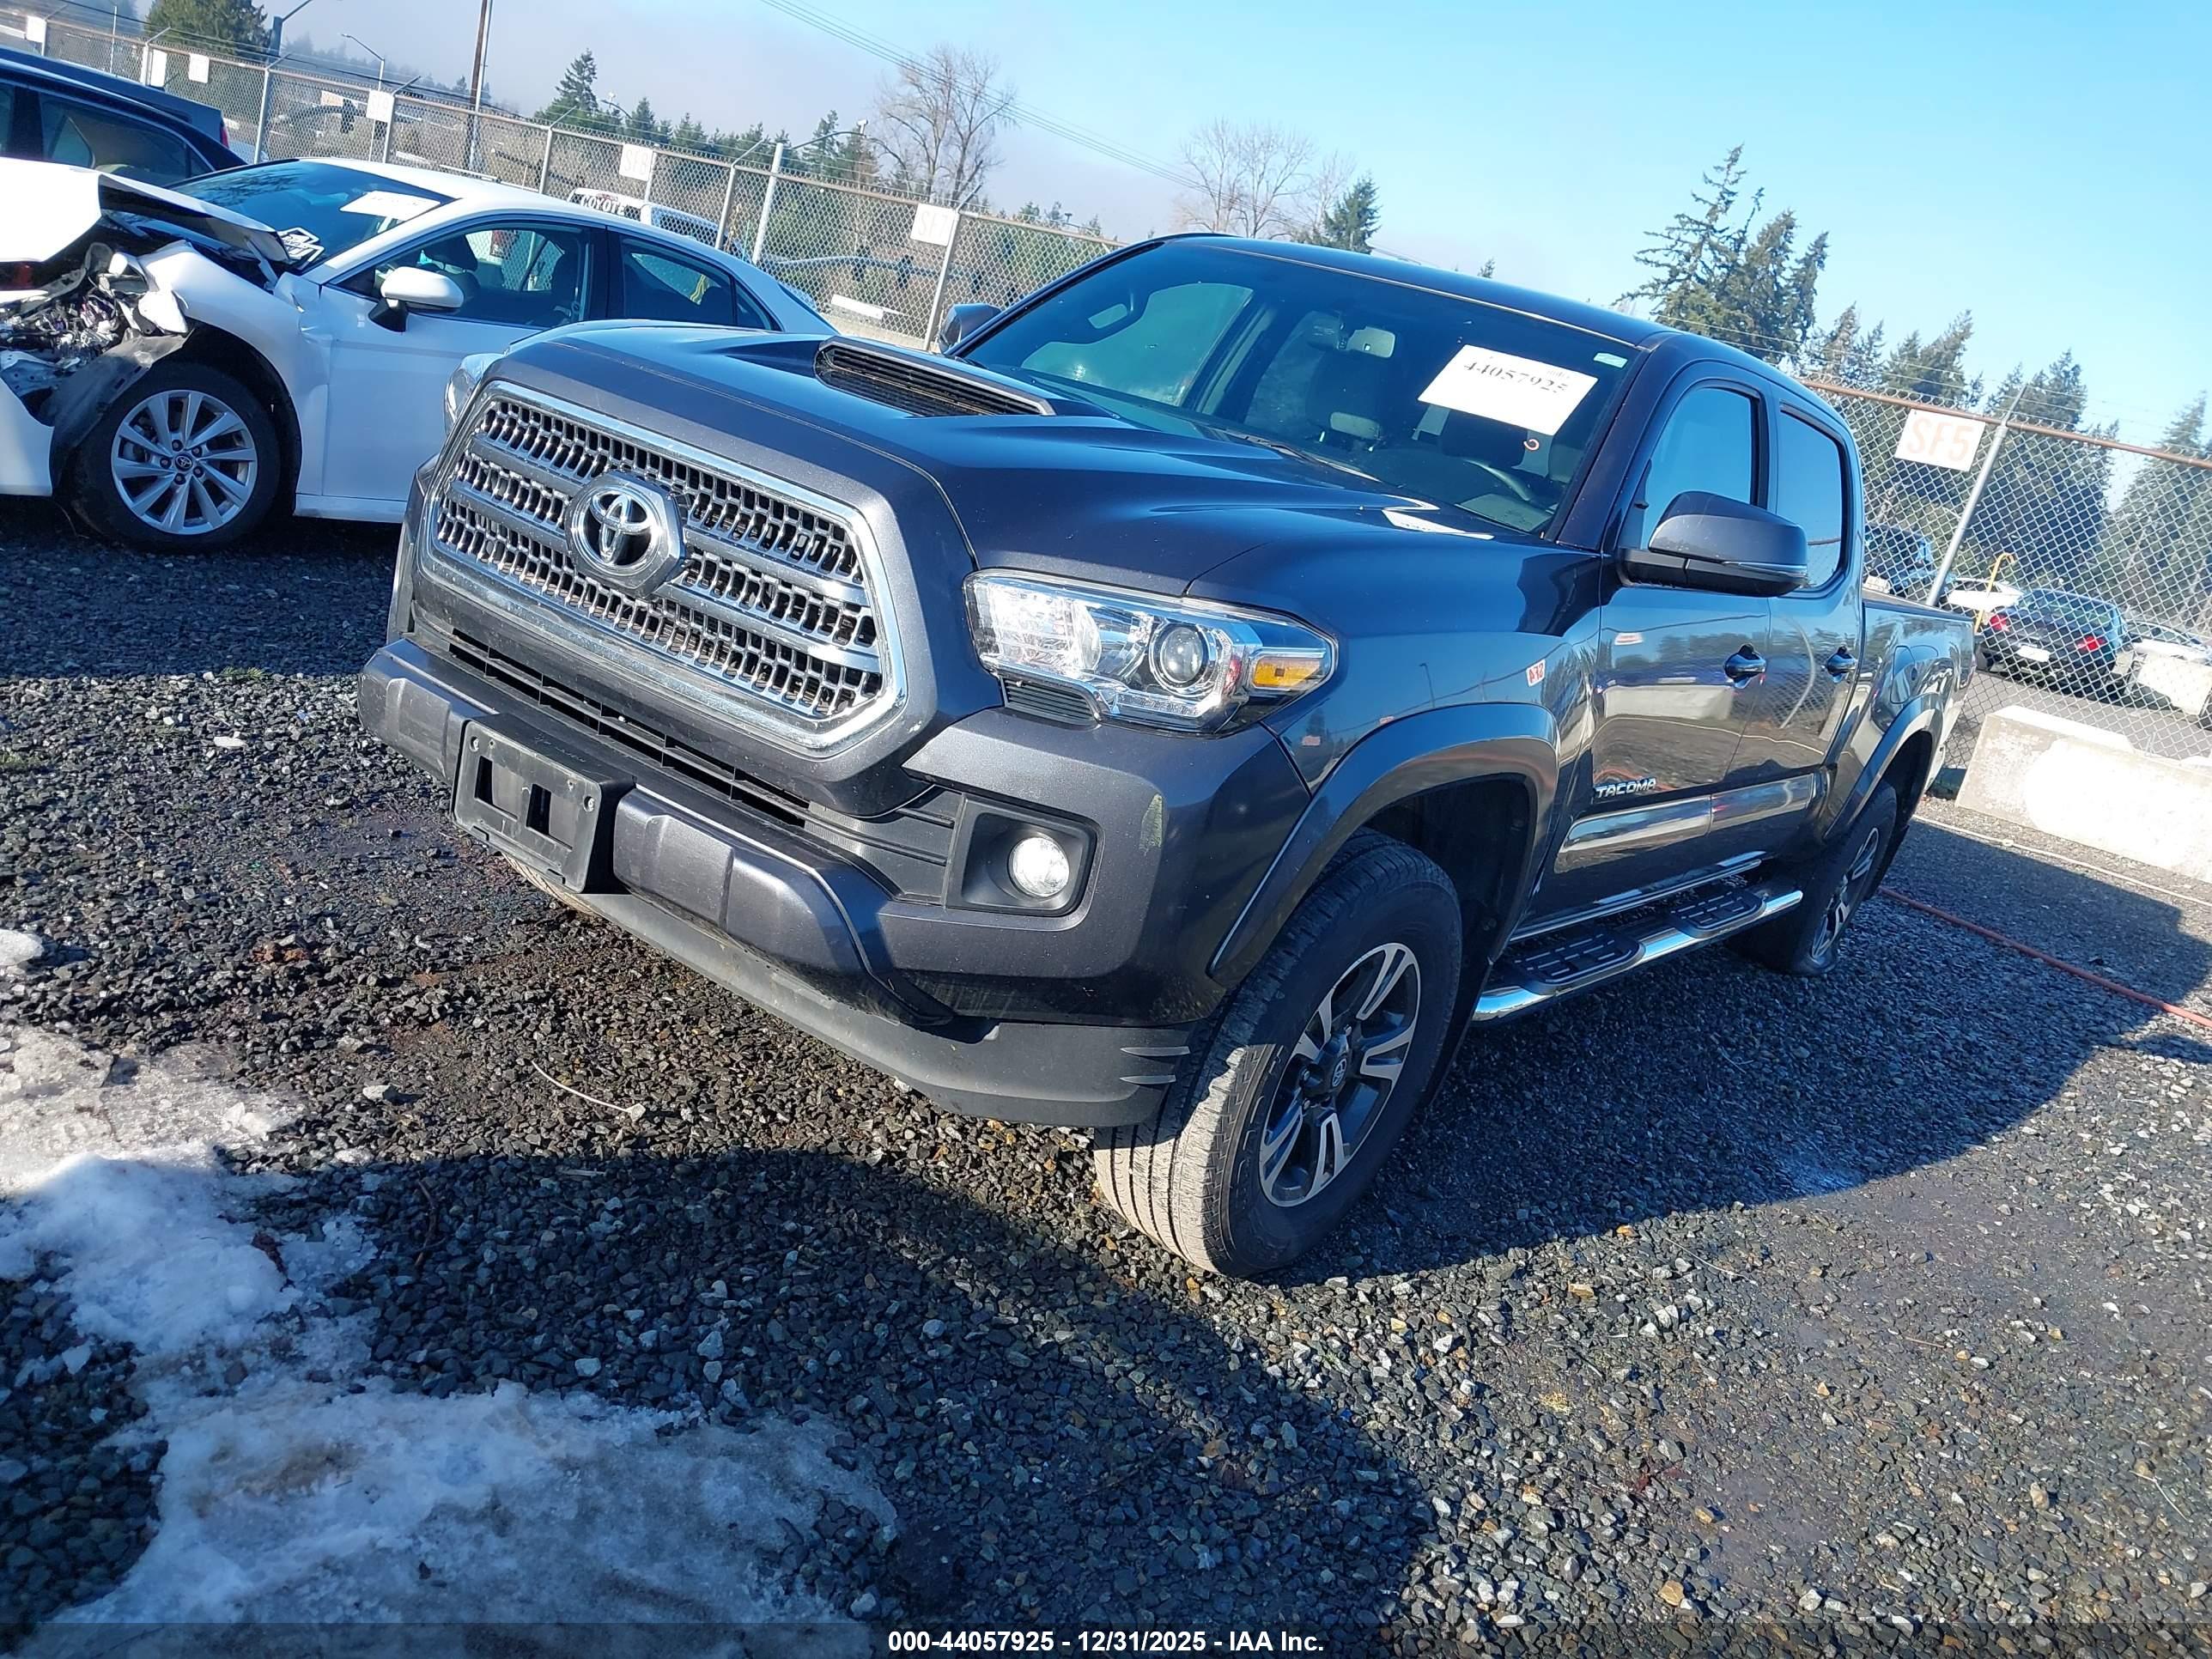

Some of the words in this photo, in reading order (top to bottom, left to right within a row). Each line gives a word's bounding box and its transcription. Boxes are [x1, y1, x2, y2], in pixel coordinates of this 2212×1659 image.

[580, 197, 626, 216] COYOTE
[917, 210, 949, 238] SF7
[1463, 361, 1569, 394] 44057925
[1906, 416, 1974, 462] SF5
[1595, 777, 1656, 799] TACOMA
